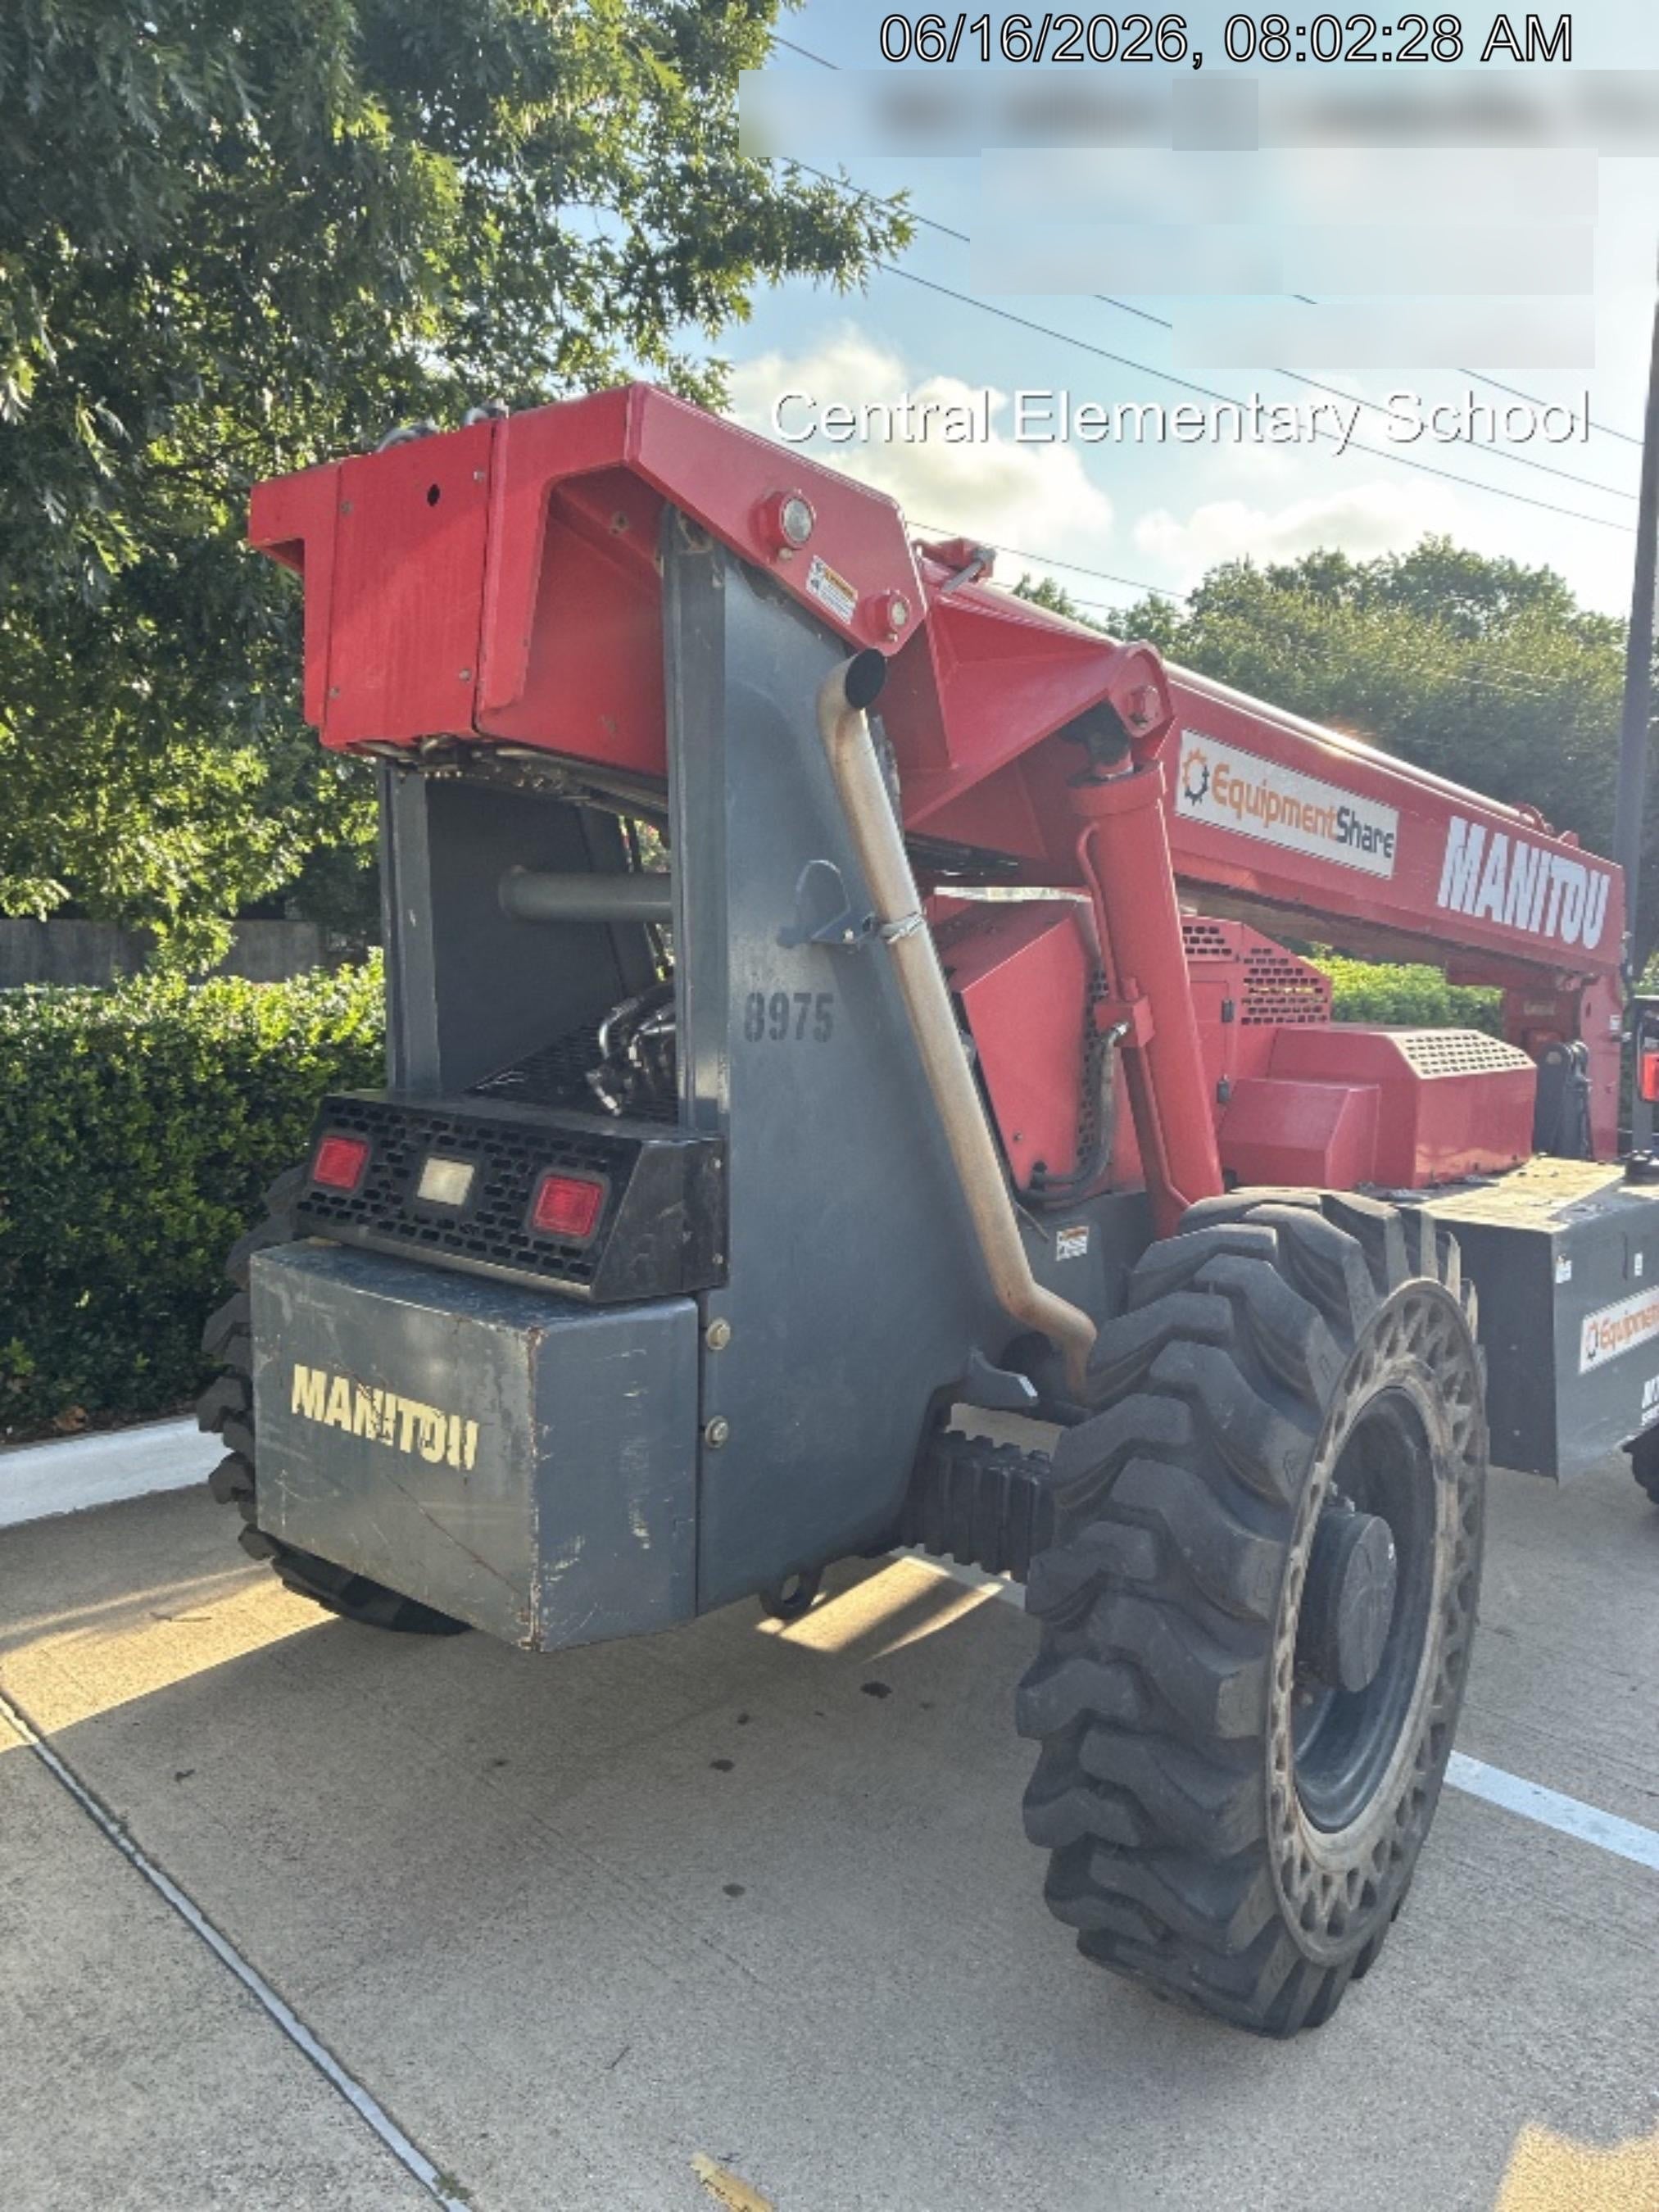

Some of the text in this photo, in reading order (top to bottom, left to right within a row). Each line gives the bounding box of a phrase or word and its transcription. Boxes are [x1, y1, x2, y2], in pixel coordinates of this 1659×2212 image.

[1211, 762, 1394, 860] EquipmentShare
[1437, 816, 1611, 950] MANITOU
[744, 992, 834, 1043] 8975
[291, 1363, 479, 1470] MANITOU
